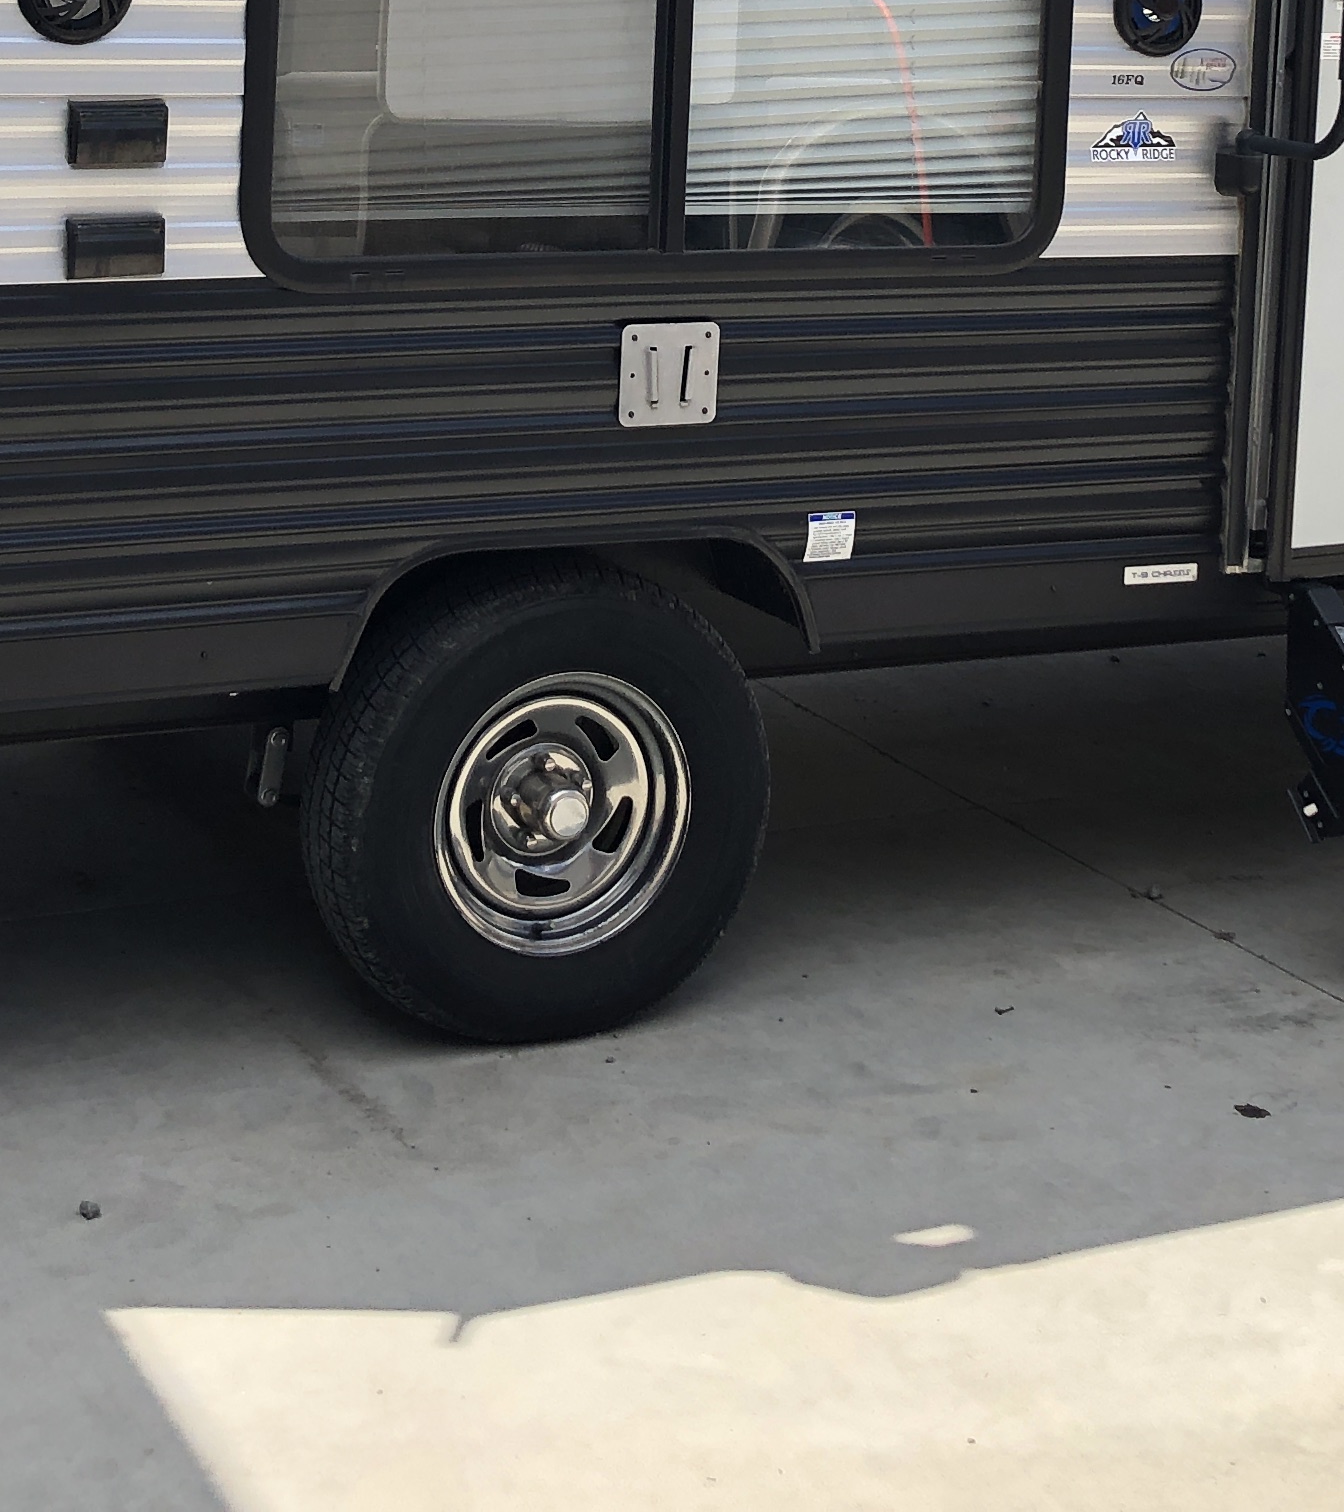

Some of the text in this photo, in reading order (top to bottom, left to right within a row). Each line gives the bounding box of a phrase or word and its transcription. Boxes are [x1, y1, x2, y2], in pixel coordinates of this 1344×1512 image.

[1111, 74, 1145, 86] 16FQ
[1092, 148, 1175, 161] ROCKY RIDGE
